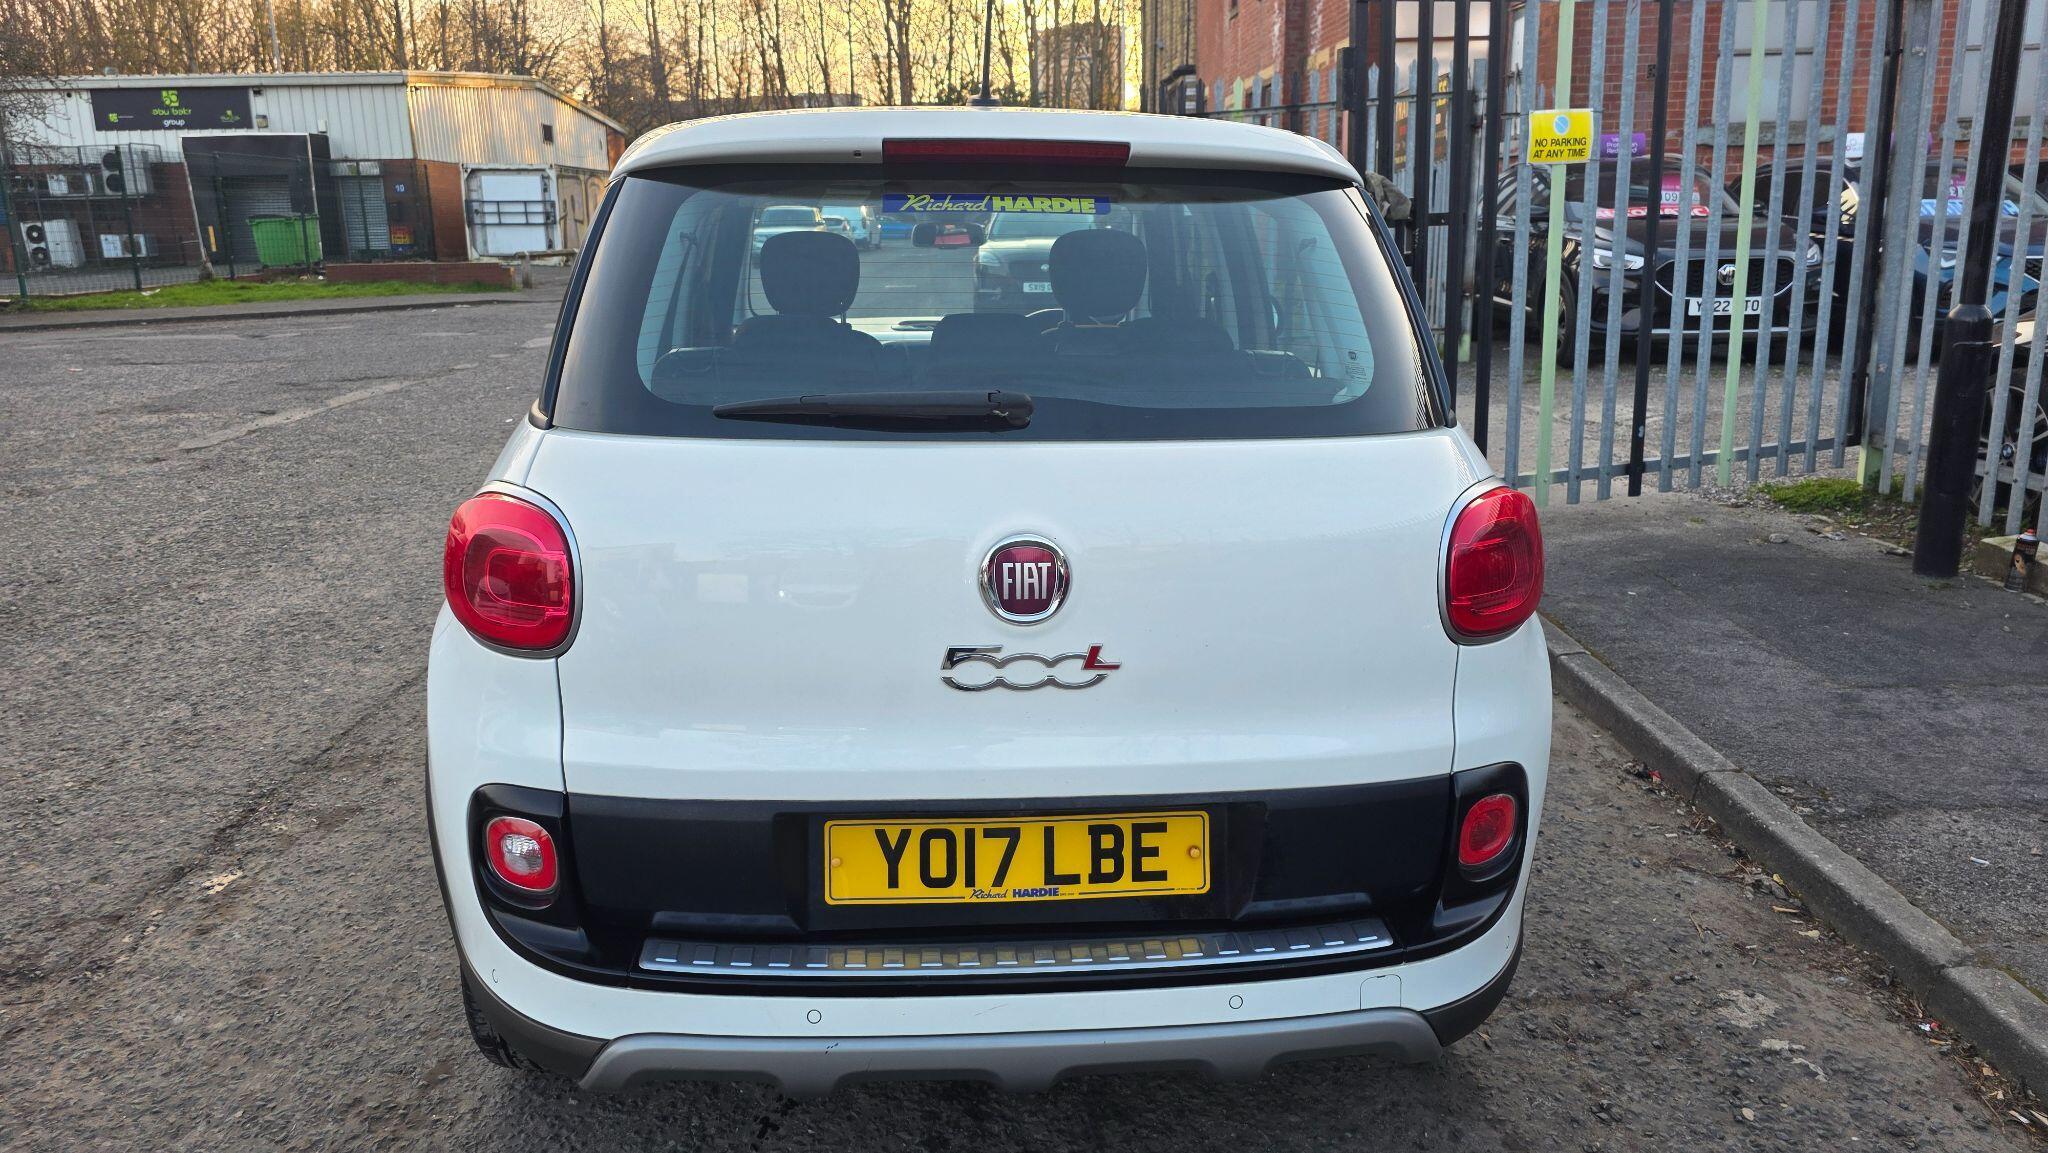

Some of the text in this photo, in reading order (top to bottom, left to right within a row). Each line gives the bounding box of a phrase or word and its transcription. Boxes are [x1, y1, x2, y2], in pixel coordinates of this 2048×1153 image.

[163, 119, 186, 128] group
[1535, 137, 1587, 147] NO PARKING
[1533, 147, 1586, 158] AT ANY TIME
[900, 194, 1097, 214] Richard HARDIE
[1696, 300, 1731, 312] Y22
[1002, 562, 1052, 601] FIAT
[874, 821, 1168, 890] YO17 LBE
[969, 888, 1009, 900] Richard
[1012, 887, 1060, 899] HARDIE
